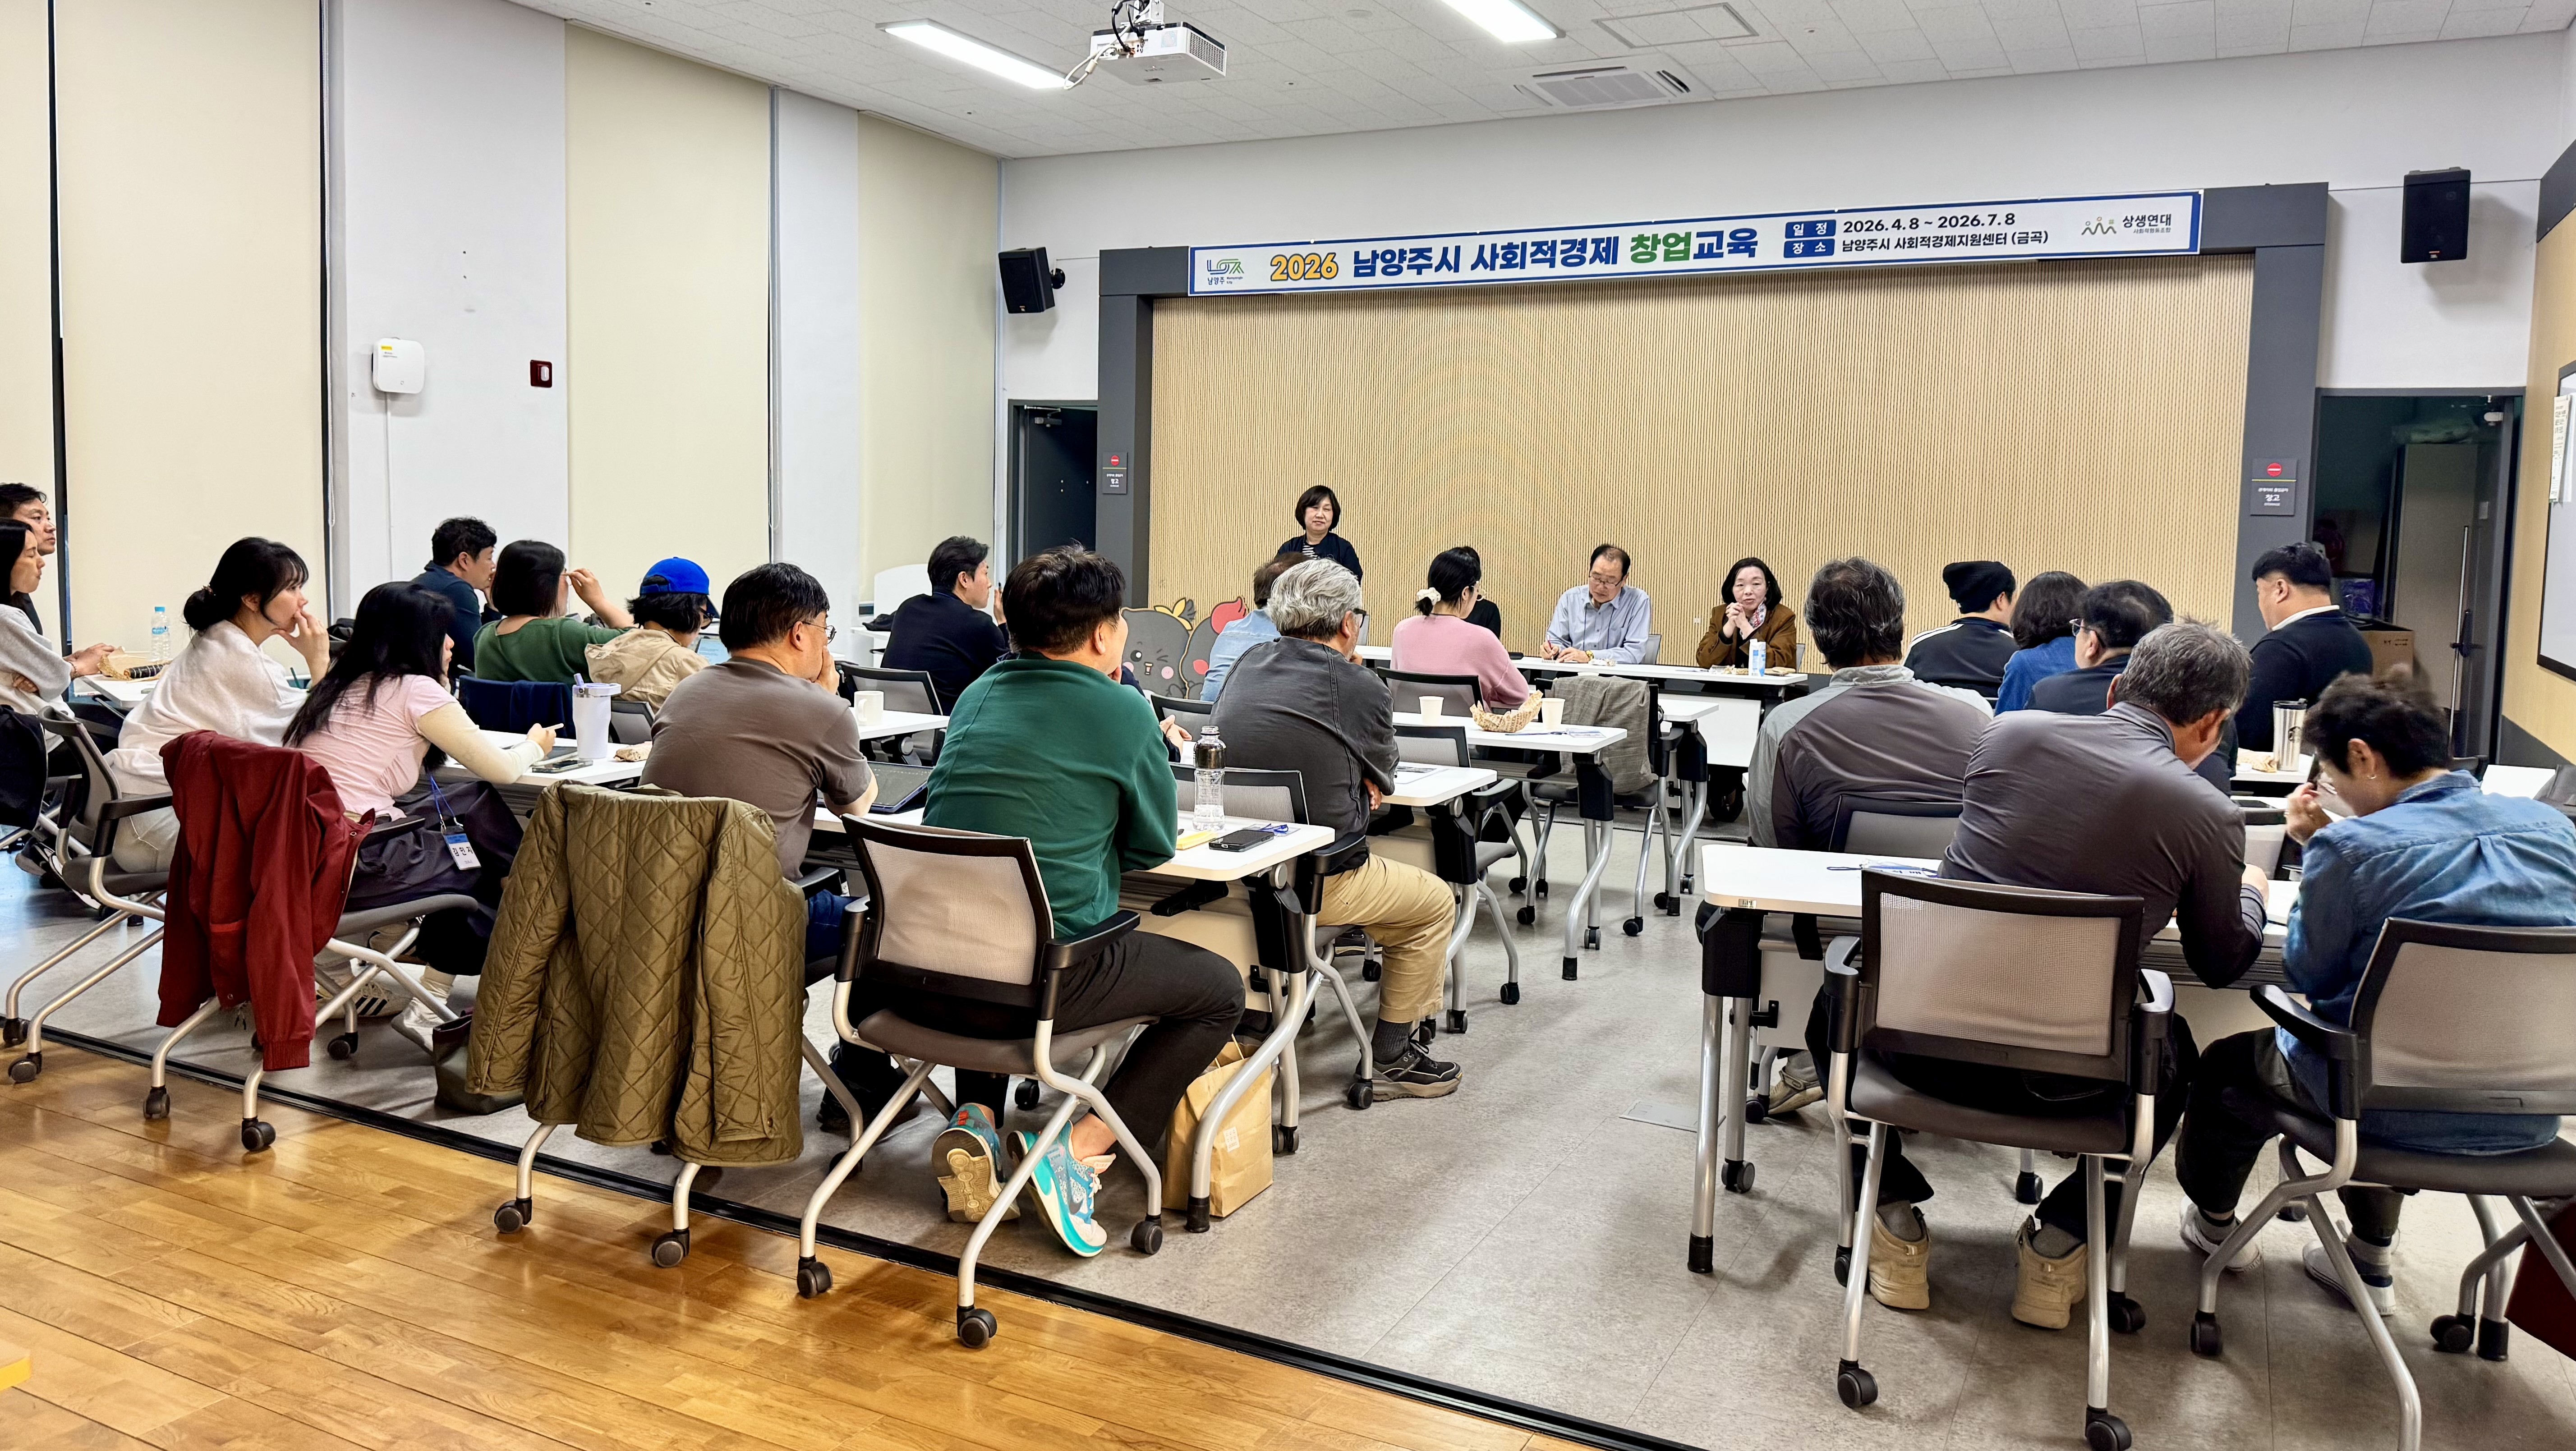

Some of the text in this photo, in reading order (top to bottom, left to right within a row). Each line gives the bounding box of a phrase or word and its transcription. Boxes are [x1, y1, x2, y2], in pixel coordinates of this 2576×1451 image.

[2122, 214, 2171, 228] 상생연대
[1842, 230, 2049, 253] 남양주시 사회적경제지원센터 (금곡)
[1270, 228, 1758, 281] 2026 남양주시 사회적경제 창업교육
[1207, 277, 1225, 285] 남양주
